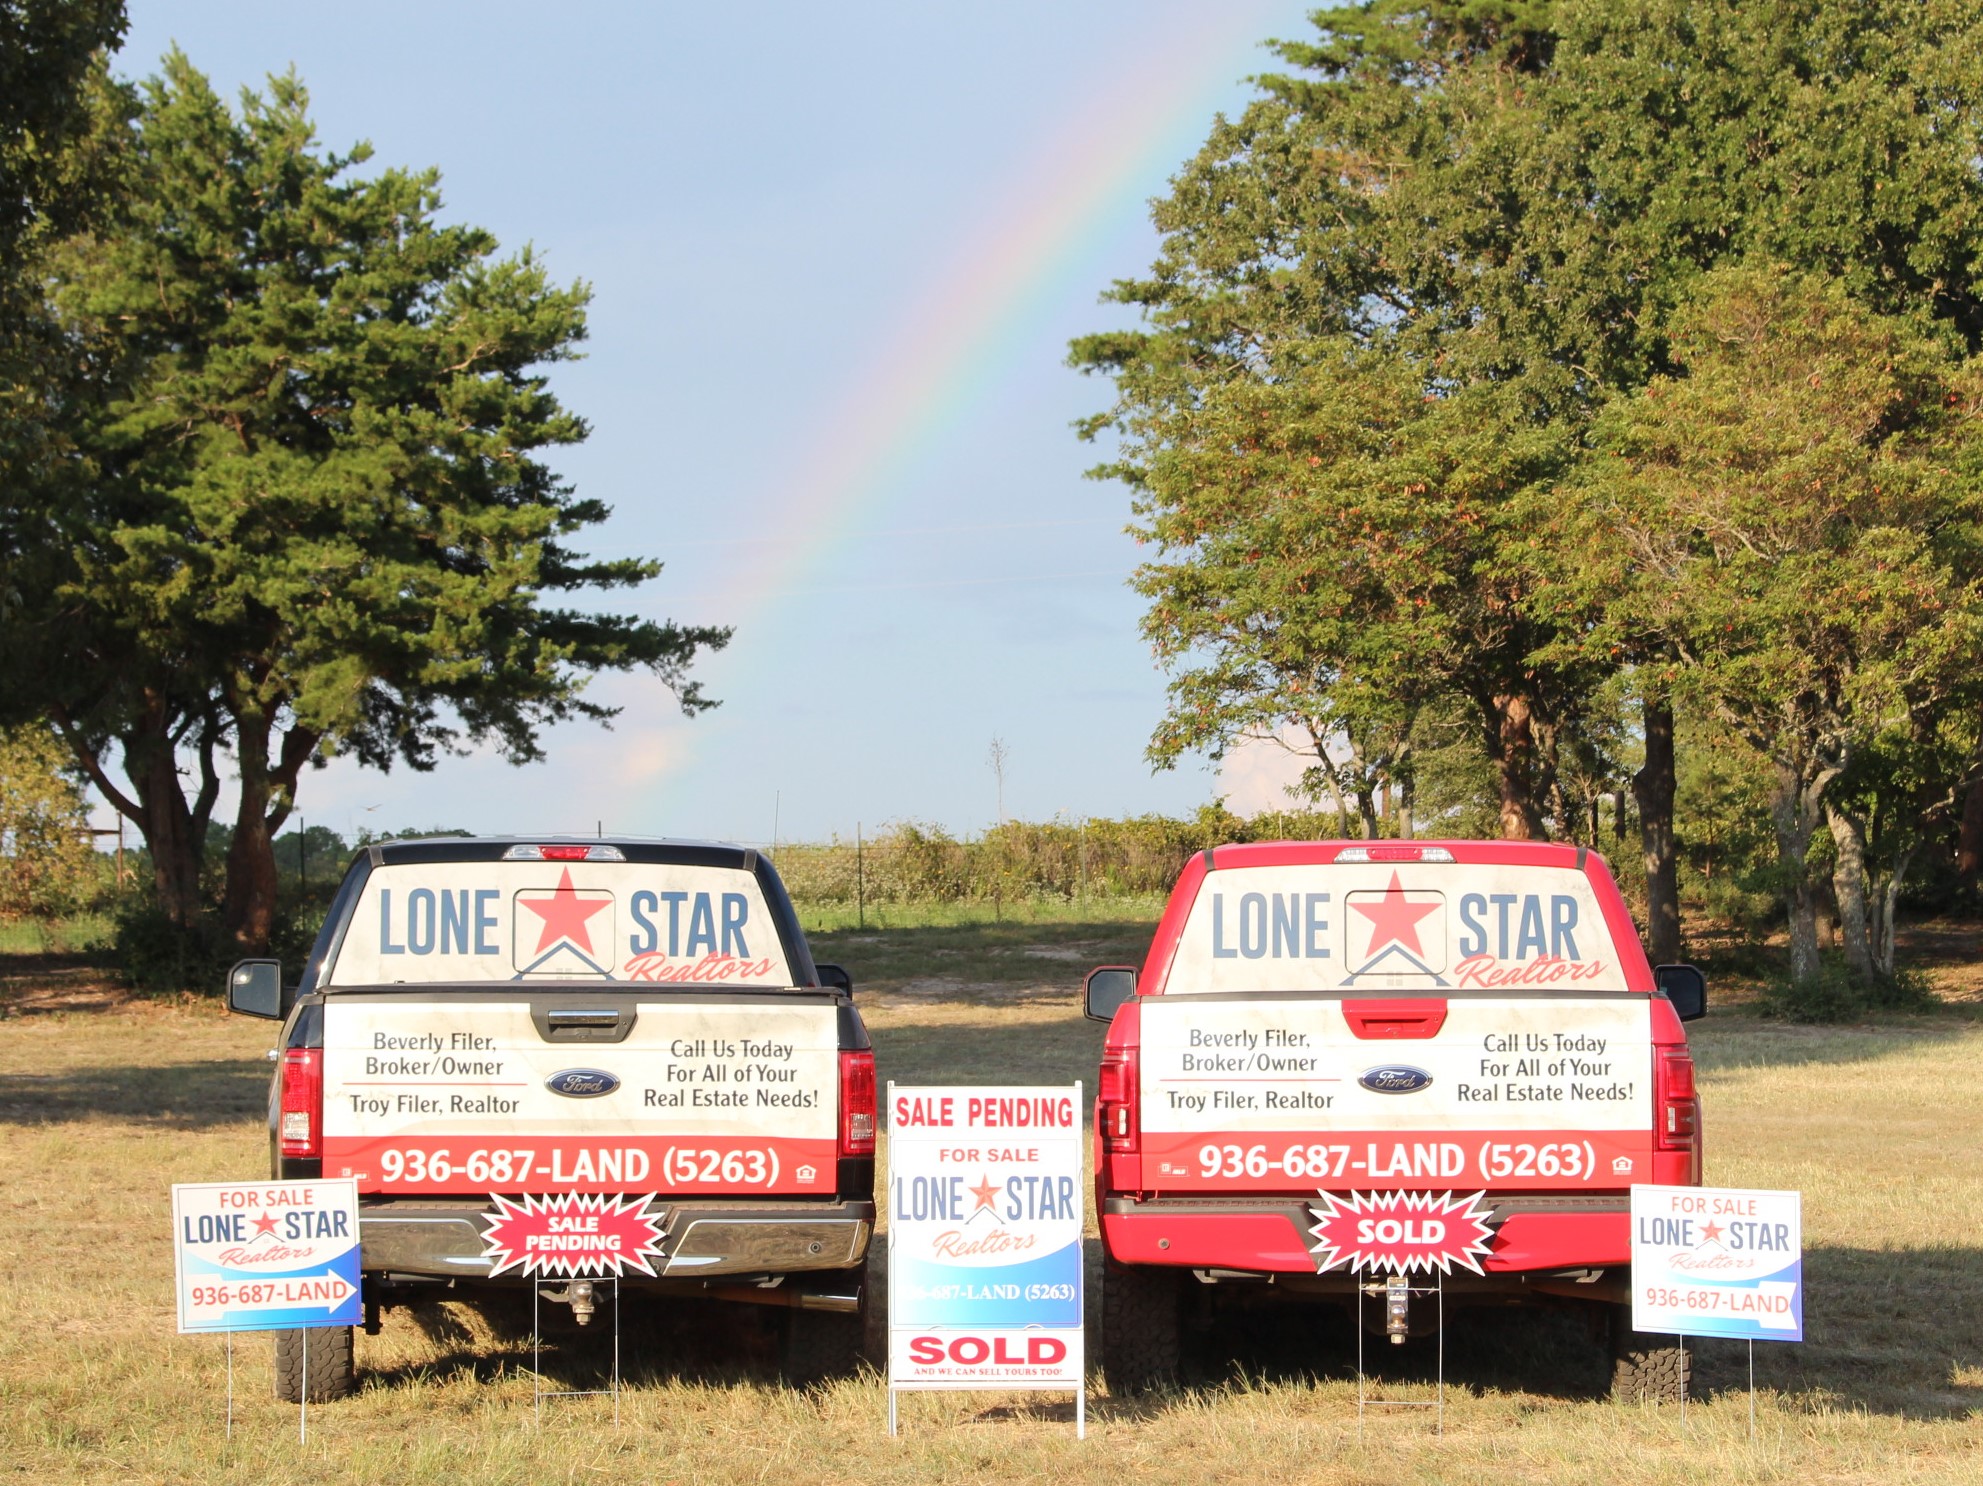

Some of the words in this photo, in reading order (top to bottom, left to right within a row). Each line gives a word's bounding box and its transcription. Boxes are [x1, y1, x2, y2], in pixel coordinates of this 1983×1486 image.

[379, 888, 501, 957] LONE
[629, 890, 751, 958] STAR
[1212, 892, 1331, 959] LONE
[1459, 892, 1581, 962] STAR
[623, 950, 778, 982] Realtors
[1453, 953, 1608, 989] Realtors
[373, 1031, 444, 1055] Beverly
[451, 1032, 497, 1053] Filer,
[670, 1039, 706, 1058] Call
[712, 1039, 736, 1058] Us
[740, 1039, 794, 1062] Today
[1189, 1029, 1259, 1051] Beverly
[1265, 1029, 1311, 1050] Filer,
[1483, 1033, 1519, 1052] Call
[1526, 1033, 1549, 1052] Us
[1553, 1033, 1607, 1056] Today
[365, 1056, 504, 1076] Broker/Owner
[667, 1064, 697, 1082] For
[702, 1064, 727, 1082] All
[734, 1064, 753, 1082] of
[756, 1064, 798, 1083] Your
[1182, 1053, 1318, 1072] Broker/Owner
[1480, 1058, 1510, 1077] For
[1515, 1058, 1541, 1077] All
[1547, 1058, 1567, 1077] of
[1569, 1058, 1612, 1077] Your
[562, 1074, 604, 1092] Ford
[1375, 1070, 1416, 1088] Ford
[644, 1088, 685, 1107] Real
[692, 1088, 749, 1107] Estate
[756, 1088, 819, 1108] Needs!
[1167, 1091, 1207, 1113] Troy
[1213, 1091, 1259, 1111] Filer,
[1265, 1090, 1335, 1109] Realtor
[1457, 1083, 1498, 1102] Real
[1506, 1083, 1564, 1102] Estate
[1570, 1082, 1634, 1101] Needs!
[350, 1095, 391, 1117] Troy
[397, 1095, 443, 1115] Filer,
[450, 1095, 520, 1114] Realtor
[895, 1096, 954, 1128] SALE
[968, 1097, 1074, 1128] PENDING
[939, 1148, 980, 1162] FOR
[987, 1148, 1040, 1162] SALE
[1198, 1143, 1466, 1179] 936-687-LAND
[1478, 1140, 1596, 1182] (5263)
[380, 1149, 650, 1183] 936-687-LAND
[662, 1146, 781, 1187] (5263)
[219, 1191, 260, 1208] FOR
[265, 1188, 314, 1207] SALE
[897, 1176, 964, 1221] LONE
[1006, 1175, 1075, 1221] STAR
[1671, 1196, 1707, 1214] FOR
[1712, 1198, 1757, 1216] SALE
[184, 1214, 247, 1244] LONE
[284, 1210, 350, 1240] STAR
[547, 1216, 599, 1233] SALE
[1356, 1219, 1446, 1245] SOLD
[1640, 1216, 1694, 1247] LONE
[1729, 1221, 1790, 1252] STAR
[525, 1234, 622, 1251] PENDING
[932, 1228, 1040, 1259] Realtors
[218, 1244, 318, 1266] Realtors
[1668, 1252, 1757, 1270] Realtors
[192, 1280, 348, 1306] 936-687-LAND
[1024, 1284, 1076, 1302] (5263)
[1646, 1287, 1790, 1314] 936-687-LAND
[908, 1336, 1067, 1365] SOLD
[914, 1368, 935, 1376] AND
[938, 1368, 952, 1376] WE
[955, 1368, 976, 1376] CAN
[979, 1368, 1002, 1376] SELL
[1004, 1368, 1038, 1376] YOURS
